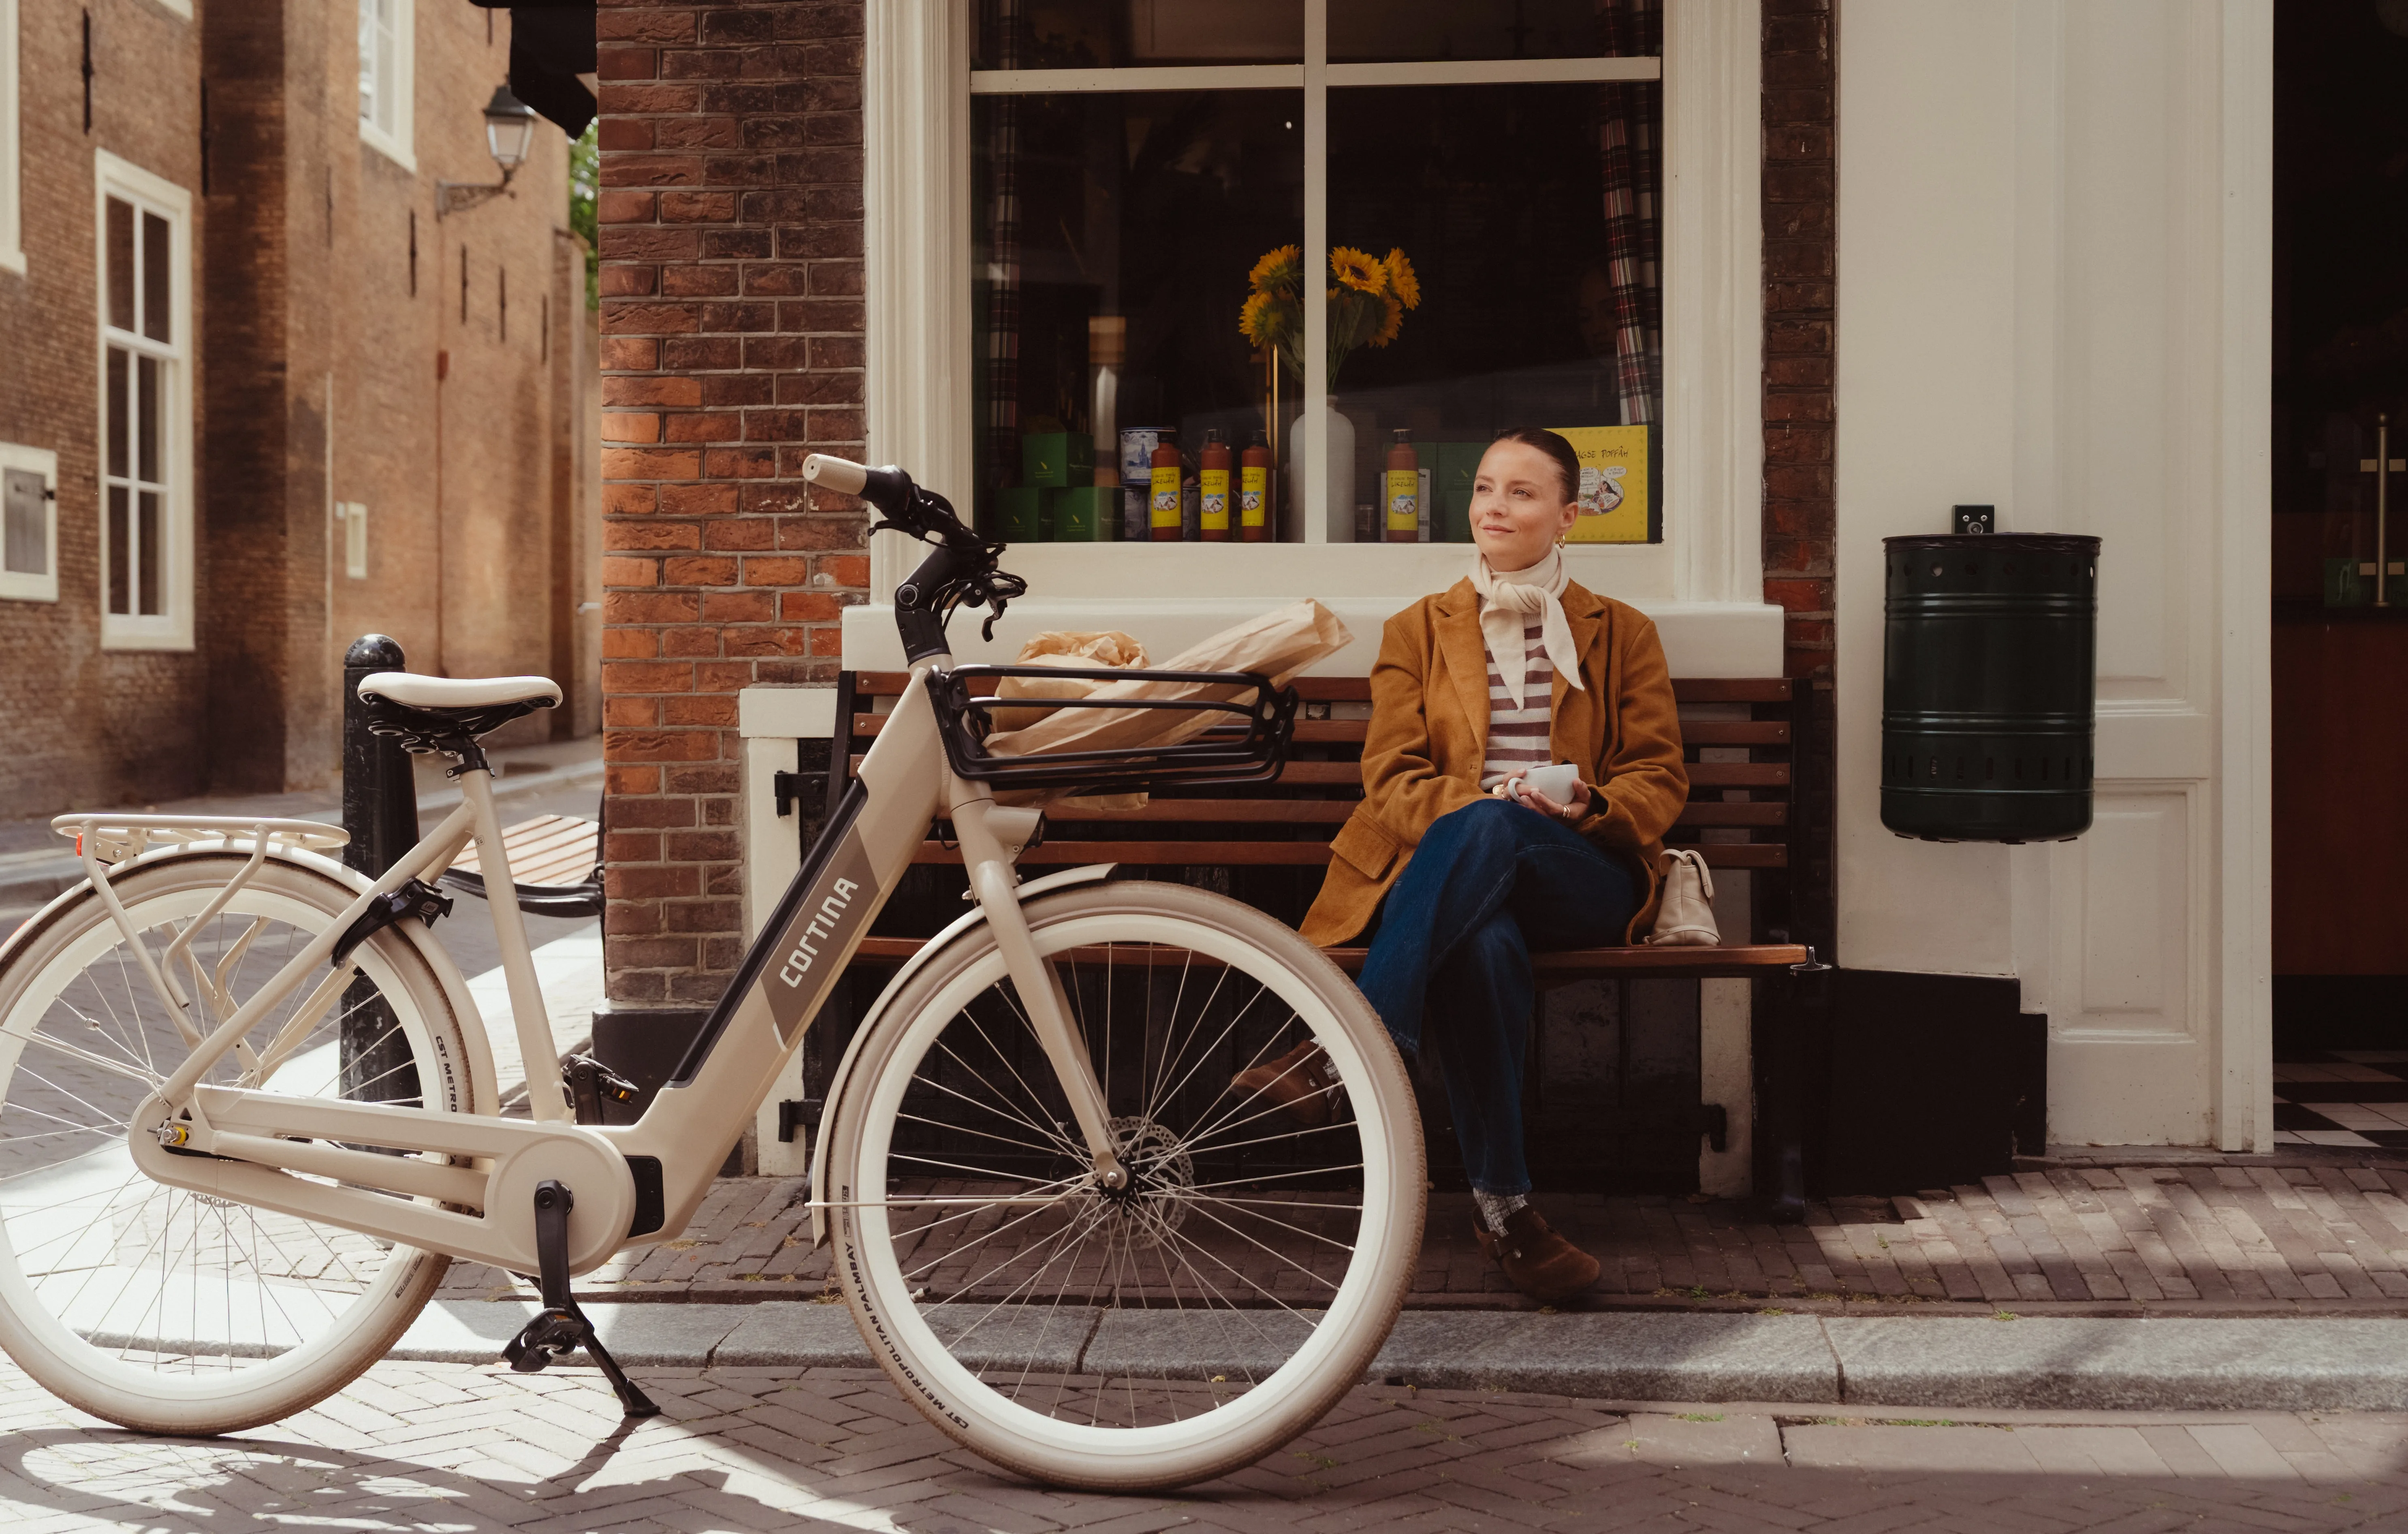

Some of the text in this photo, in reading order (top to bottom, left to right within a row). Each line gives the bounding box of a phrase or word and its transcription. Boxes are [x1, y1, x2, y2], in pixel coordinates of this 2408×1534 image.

[1575, 445, 1629, 459] AGSE POFFÂH
[780, 878, 858, 987] CORTINA
[436, 1036, 457, 1112] CST METRO
[845, 1241, 969, 1429] CST METROPOLITAN PALMBAY
